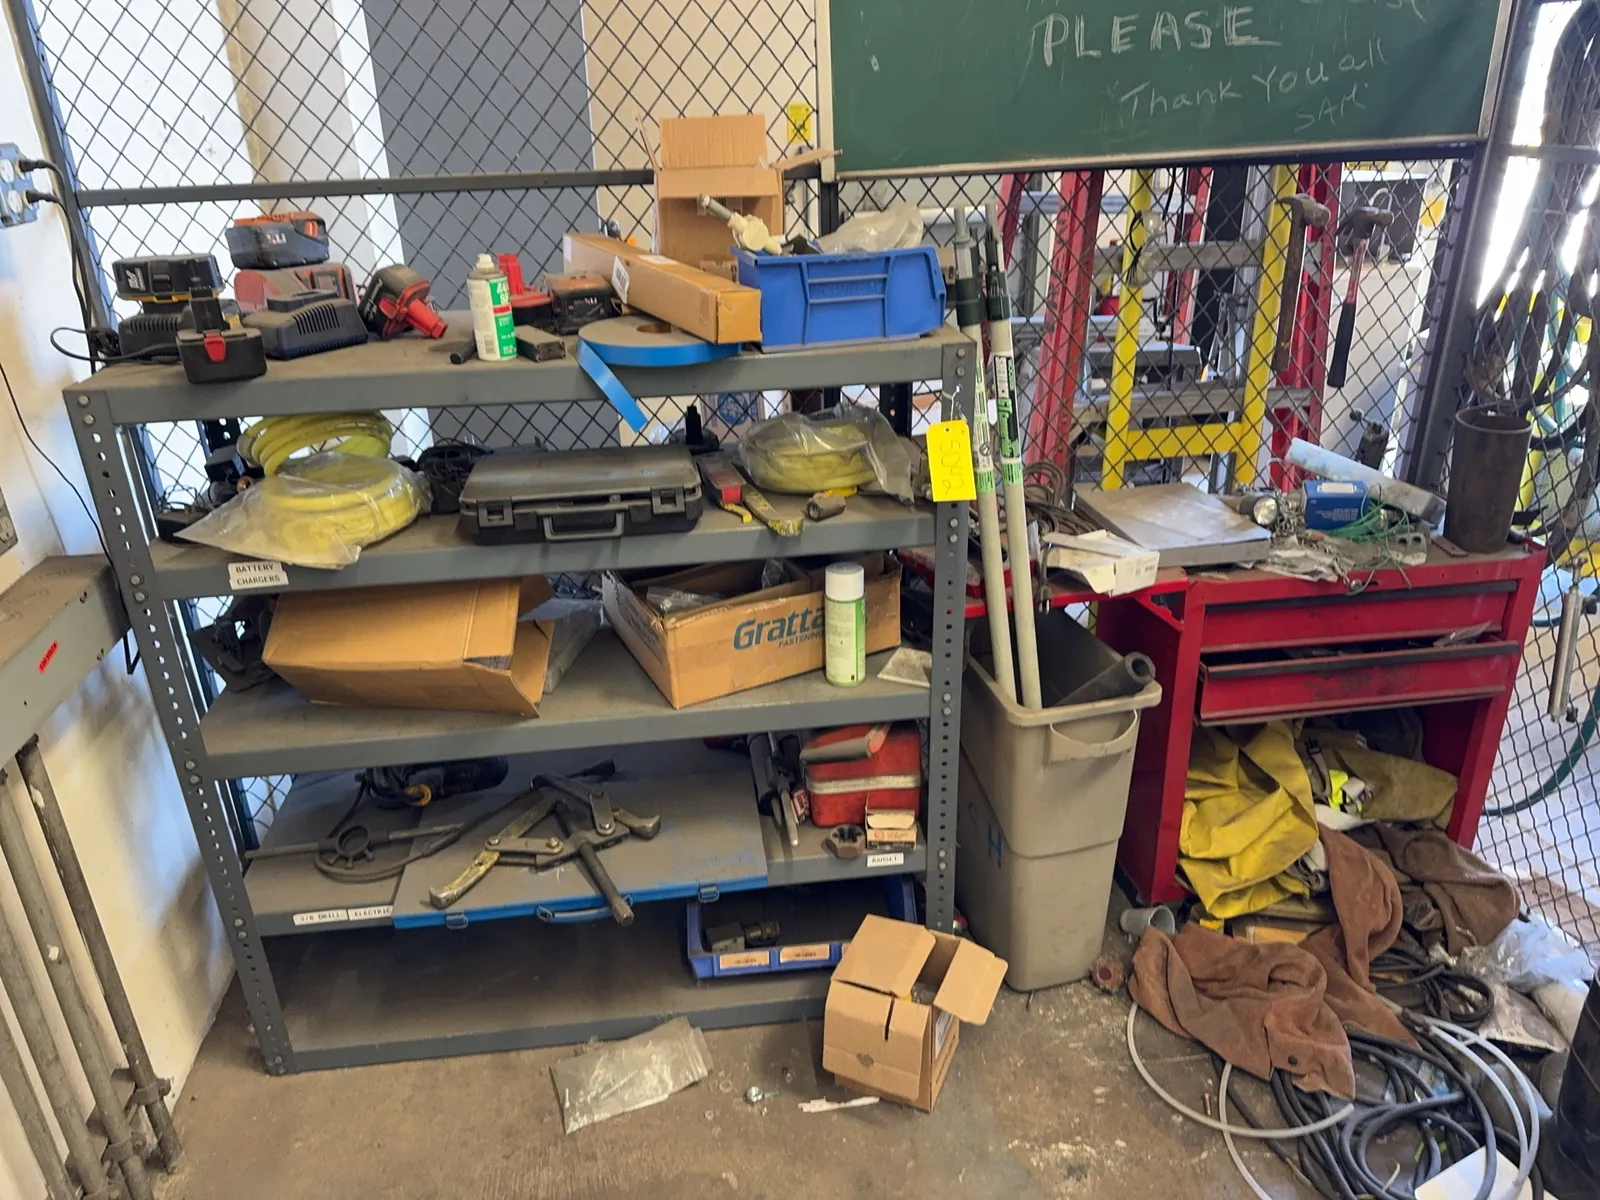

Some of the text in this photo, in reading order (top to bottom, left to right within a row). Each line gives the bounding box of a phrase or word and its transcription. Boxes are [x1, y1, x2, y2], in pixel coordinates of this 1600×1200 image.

[1040, 5, 1280, 67] PLEASE
[1120, 78, 1241, 118] Thank
[1339, 38, 1389, 72] all
[939, 439, 965, 495] 5042
[235, 562, 274, 573] BATTERY
[236, 574, 281, 586] CHARGERS
